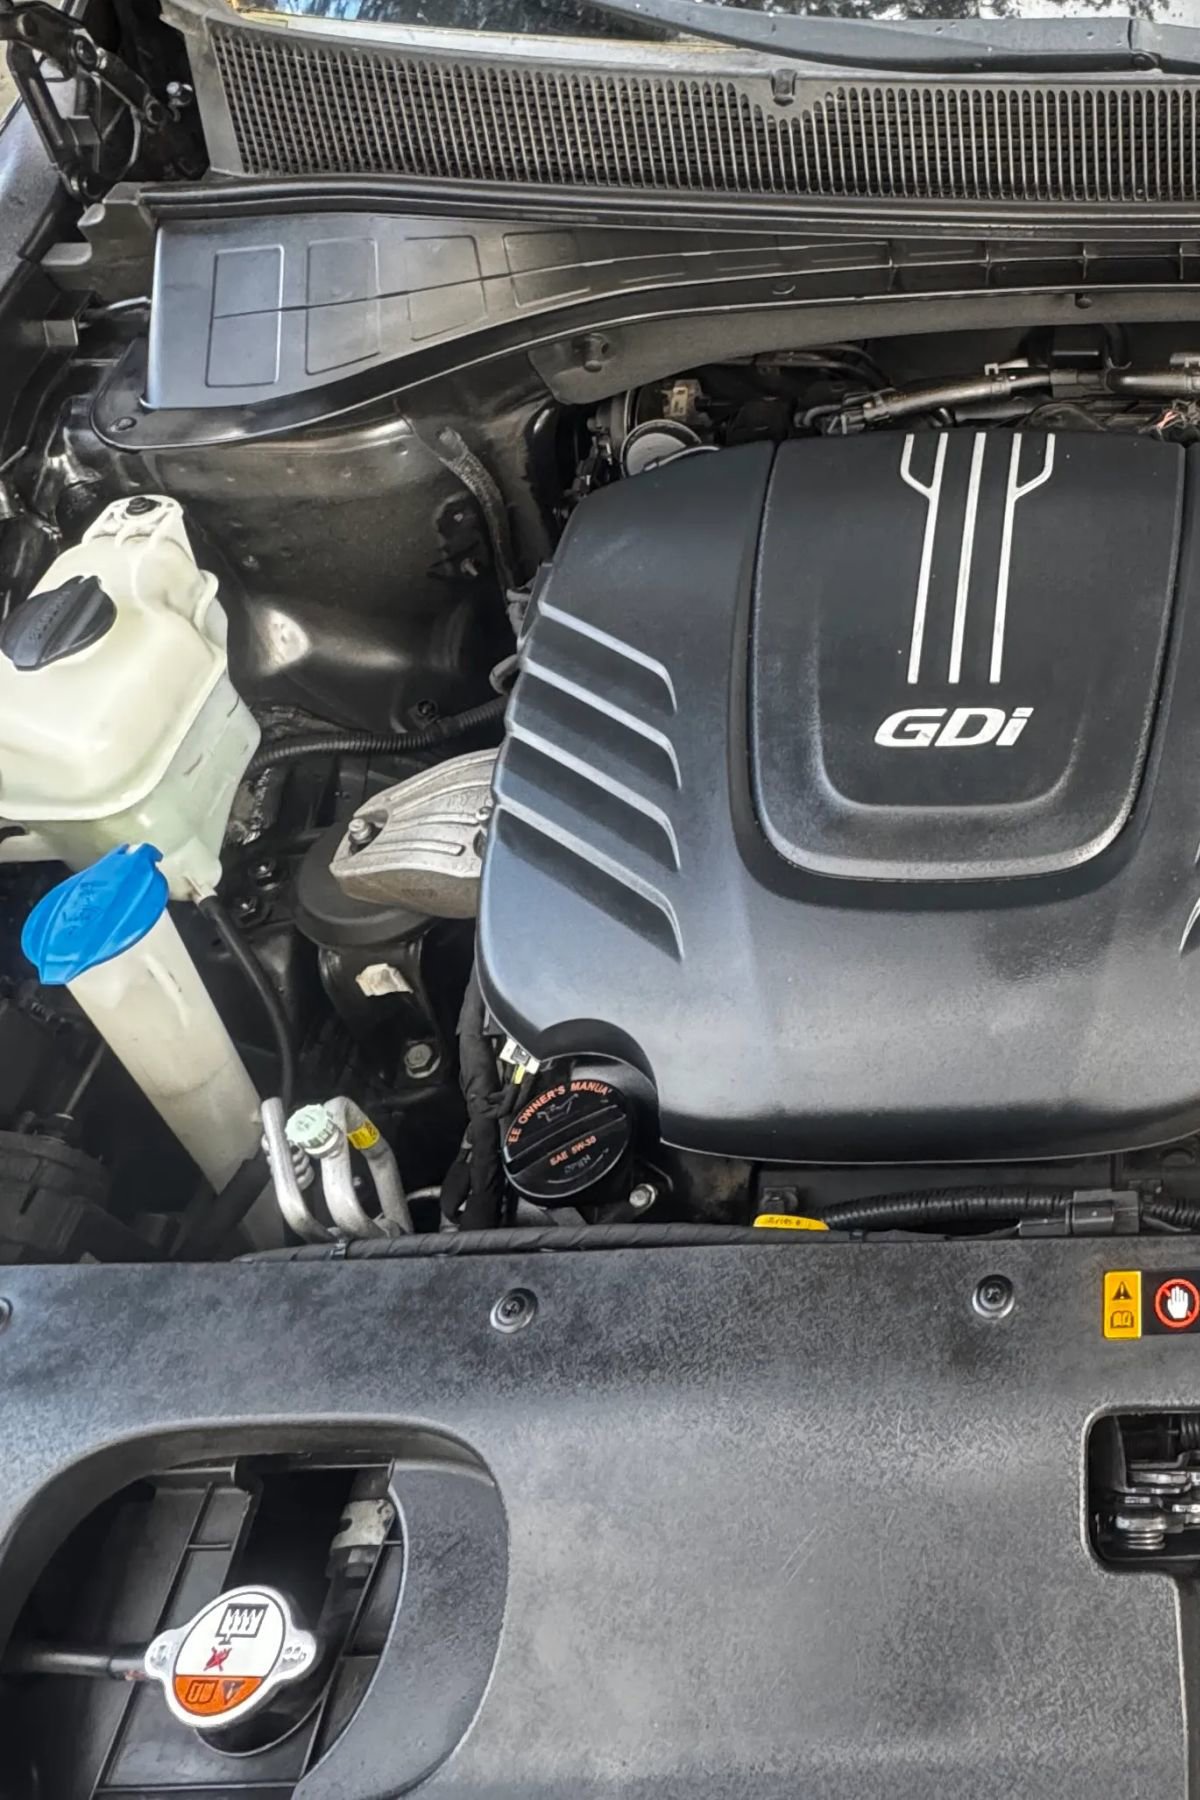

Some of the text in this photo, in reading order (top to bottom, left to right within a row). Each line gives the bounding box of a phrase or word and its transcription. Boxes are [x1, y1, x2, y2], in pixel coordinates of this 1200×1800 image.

[874, 707, 1034, 747] GDi
[508, 1127, 522, 1144] EE
[518, 1085, 566, 1125] OWNER'S
[549, 1135, 597, 1166] SAE 5W-30
